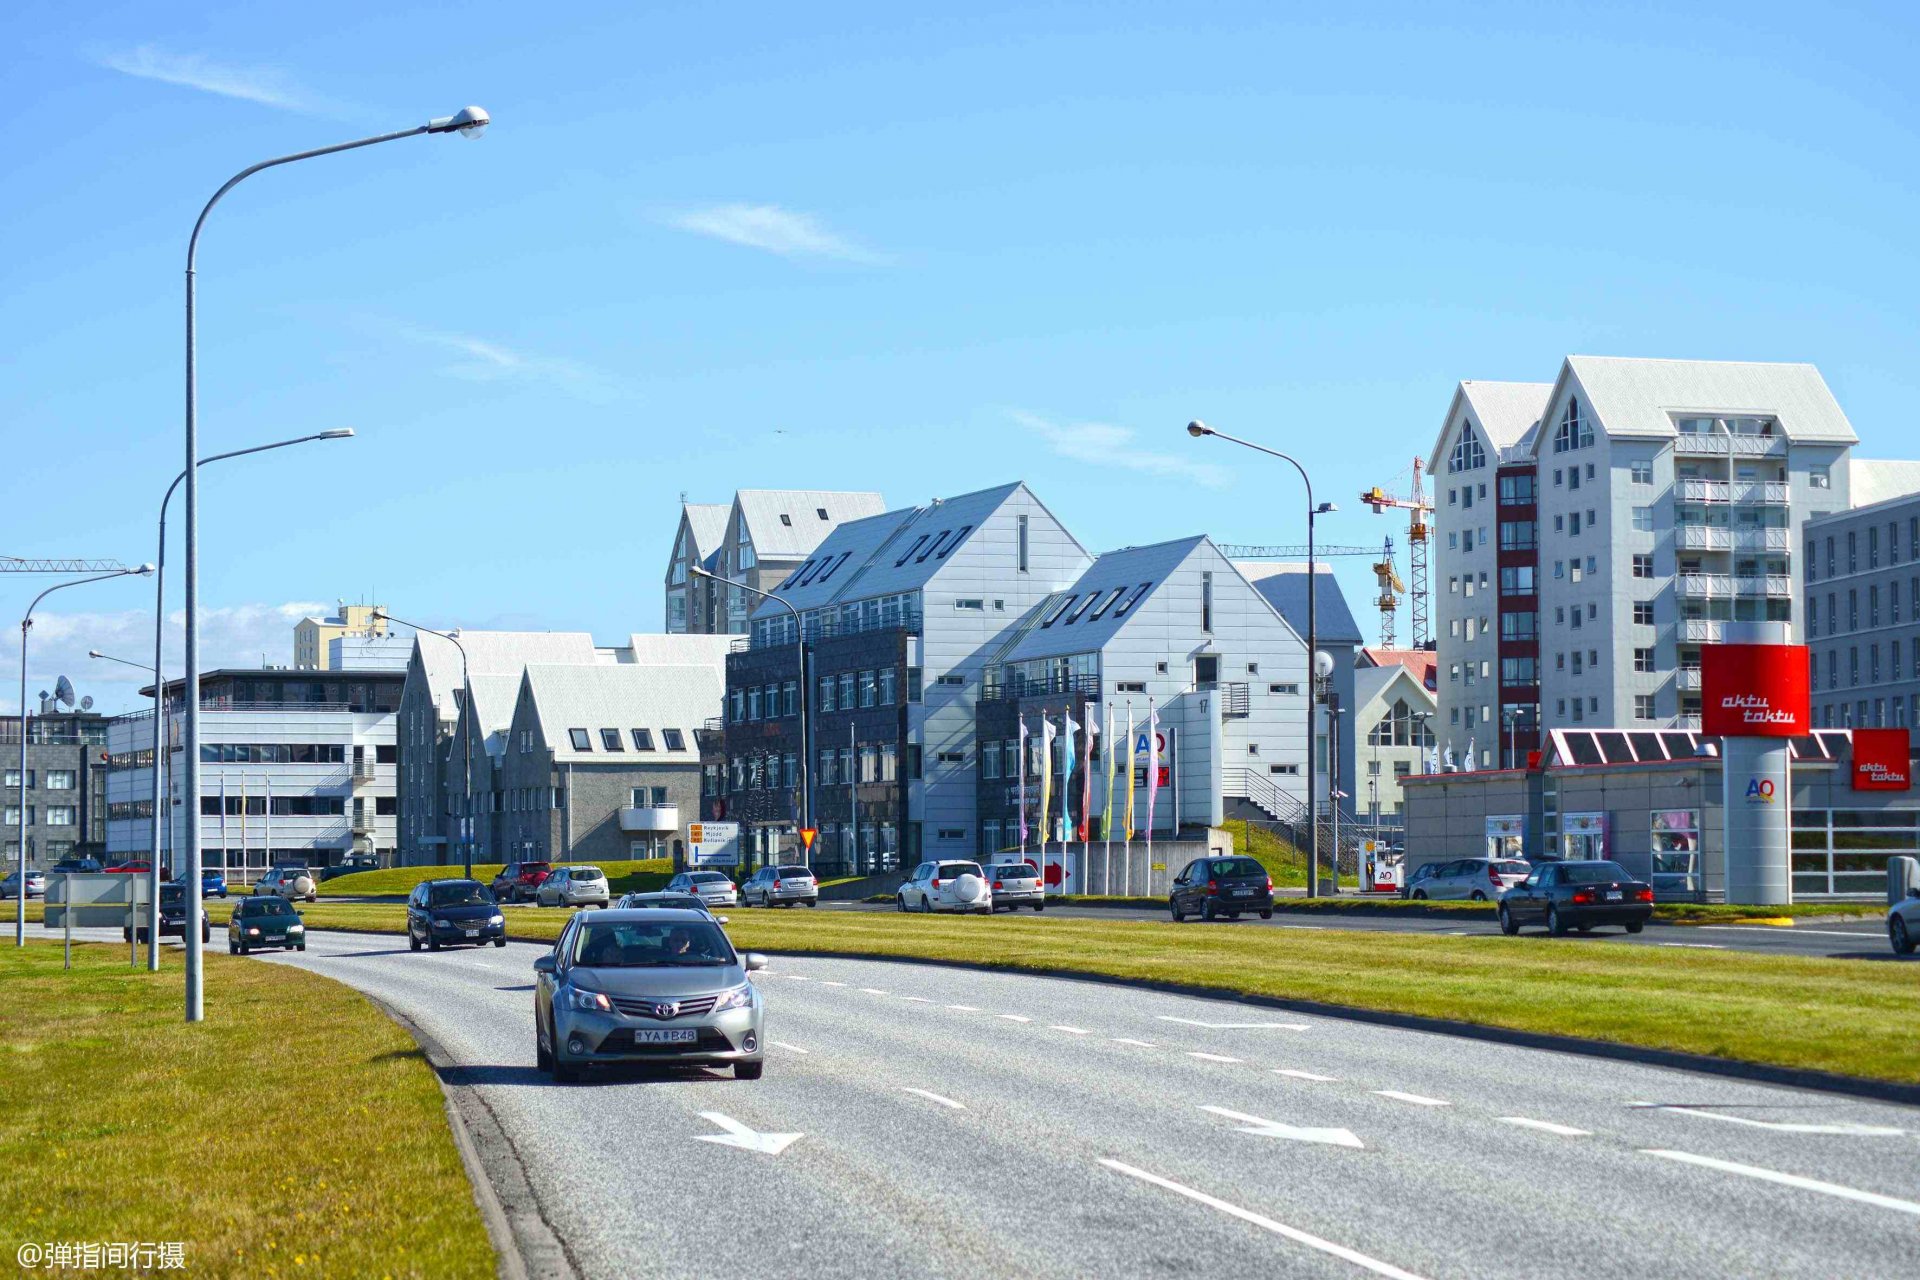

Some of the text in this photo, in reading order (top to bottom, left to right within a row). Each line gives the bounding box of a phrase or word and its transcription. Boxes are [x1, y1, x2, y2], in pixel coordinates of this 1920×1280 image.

[1199, 699, 1208, 713] 17
[1721, 694, 1769, 708] aktu
[1743, 709, 1796, 724] taktu
[1859, 762, 1888, 772] aktu
[1870, 772, 1905, 782] taktu
